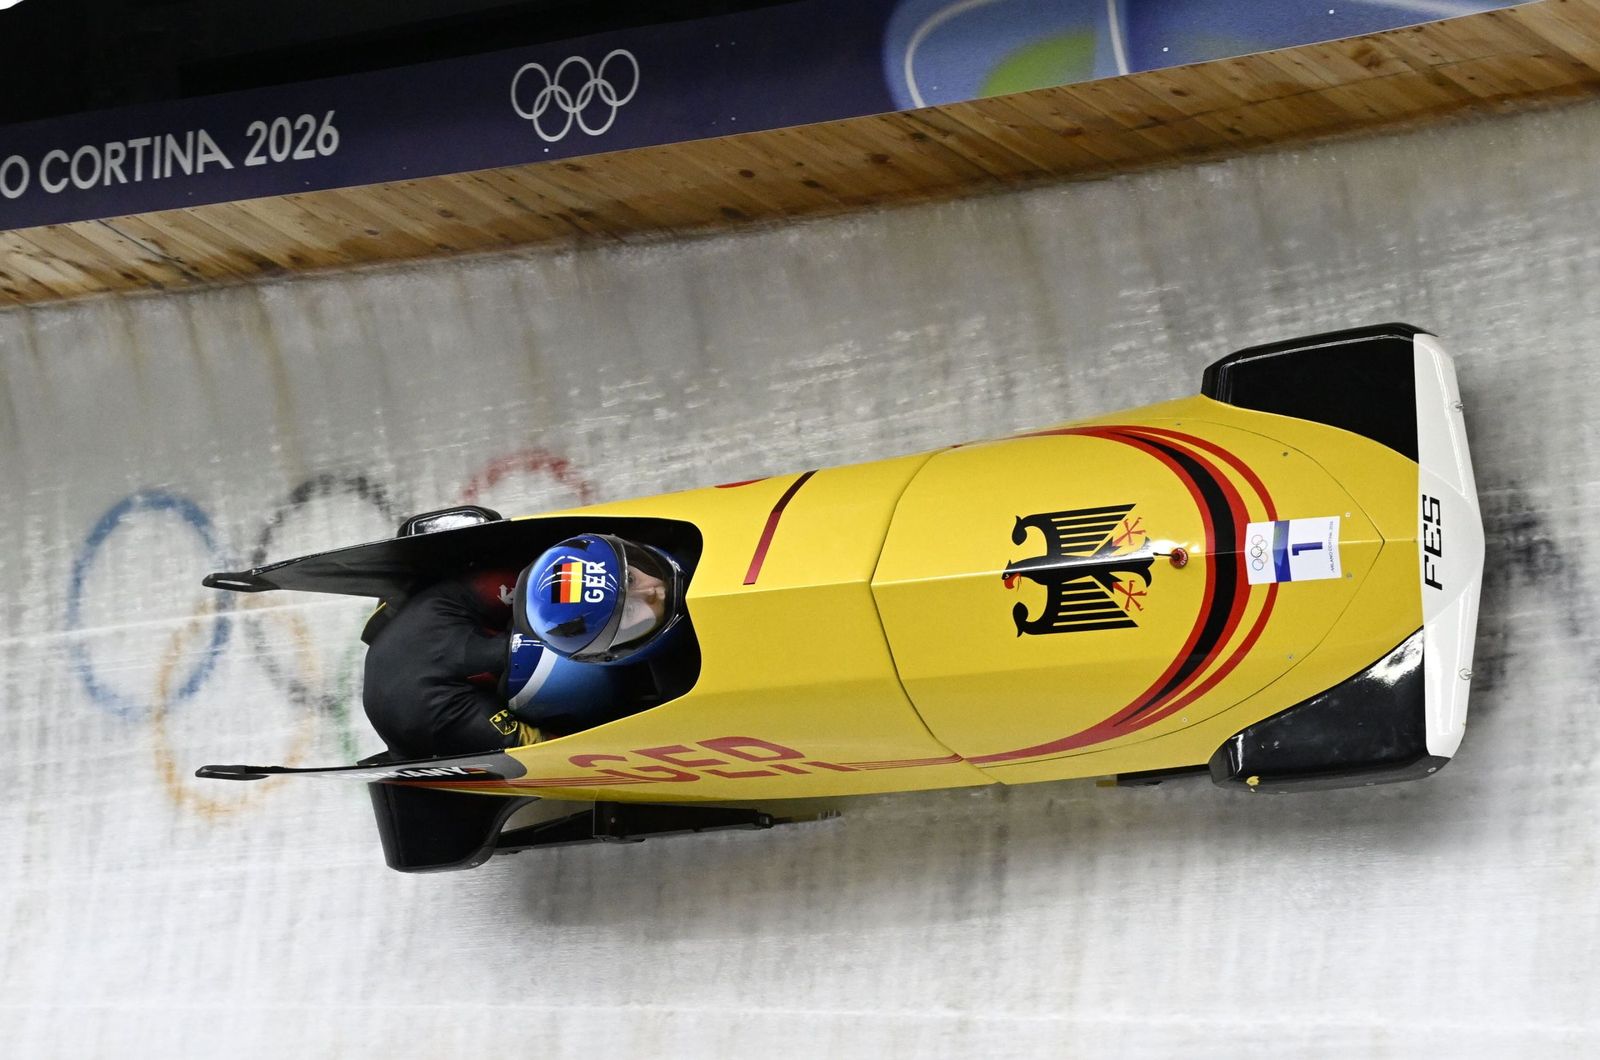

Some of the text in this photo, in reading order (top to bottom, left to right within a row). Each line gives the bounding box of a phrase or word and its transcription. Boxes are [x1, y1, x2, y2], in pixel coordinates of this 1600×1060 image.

[39, 129, 235, 194] CORTINA
[244, 110, 340, 167] 2026
[1292, 541, 1323, 556] 1
[1422, 494, 1442, 591] FES
[584, 561, 607, 603] GER
